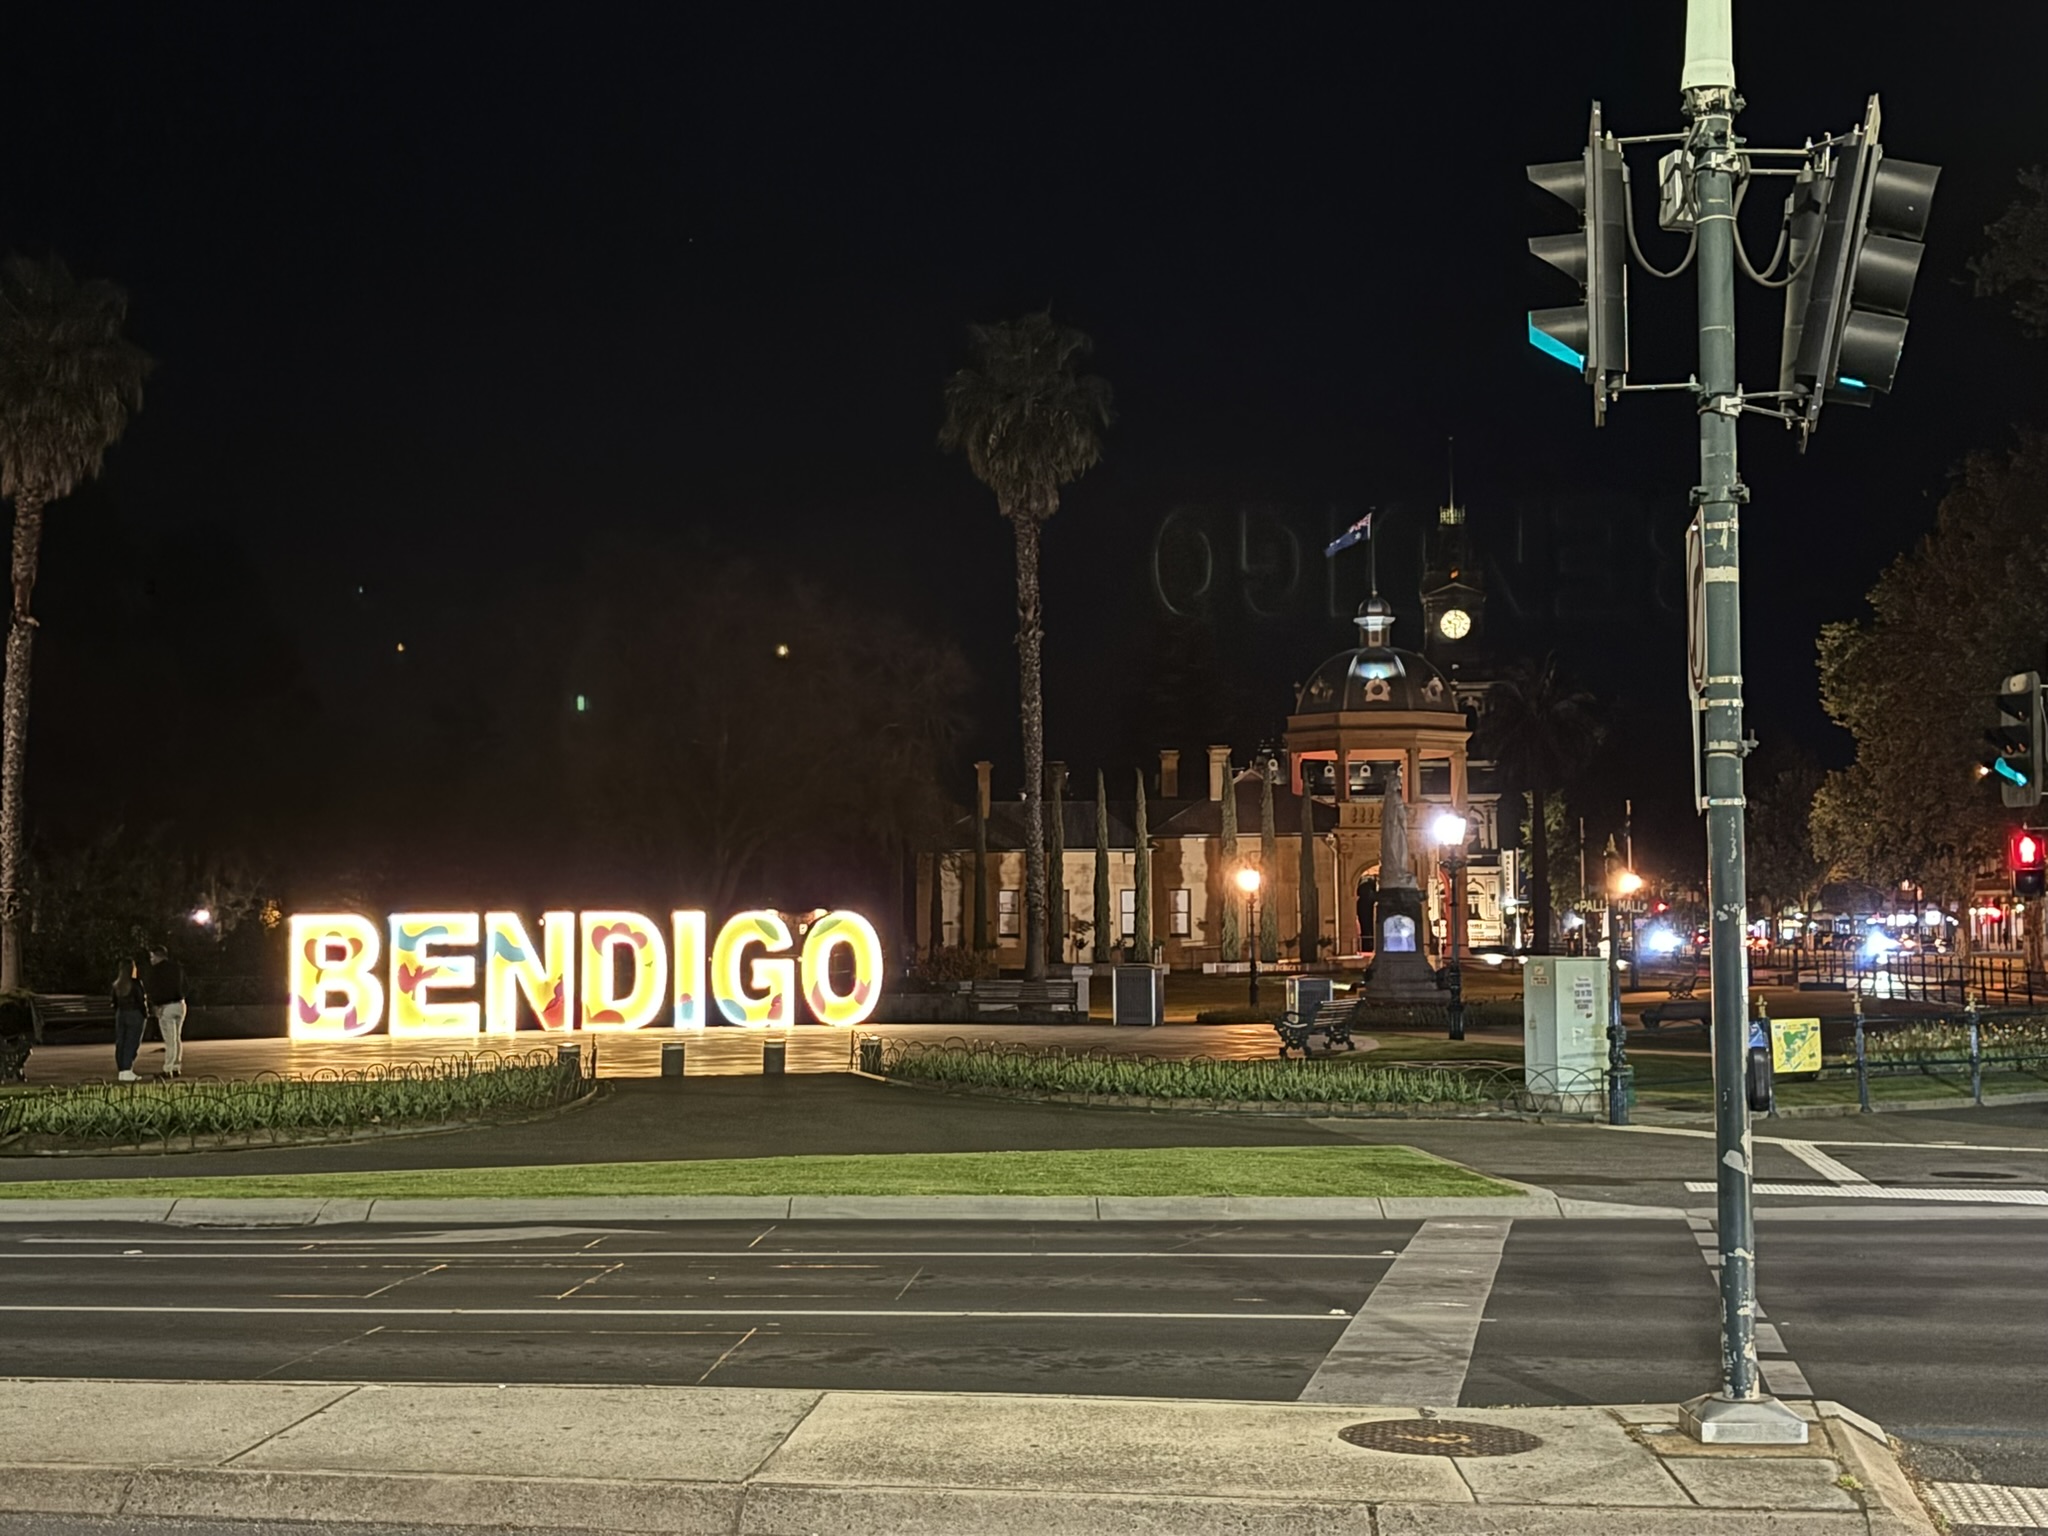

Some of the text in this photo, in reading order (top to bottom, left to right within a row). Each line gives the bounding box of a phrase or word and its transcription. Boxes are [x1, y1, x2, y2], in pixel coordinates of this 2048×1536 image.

[1580, 900, 1643, 912] PALL MALL
[289, 910, 884, 1038] BENDIGO
